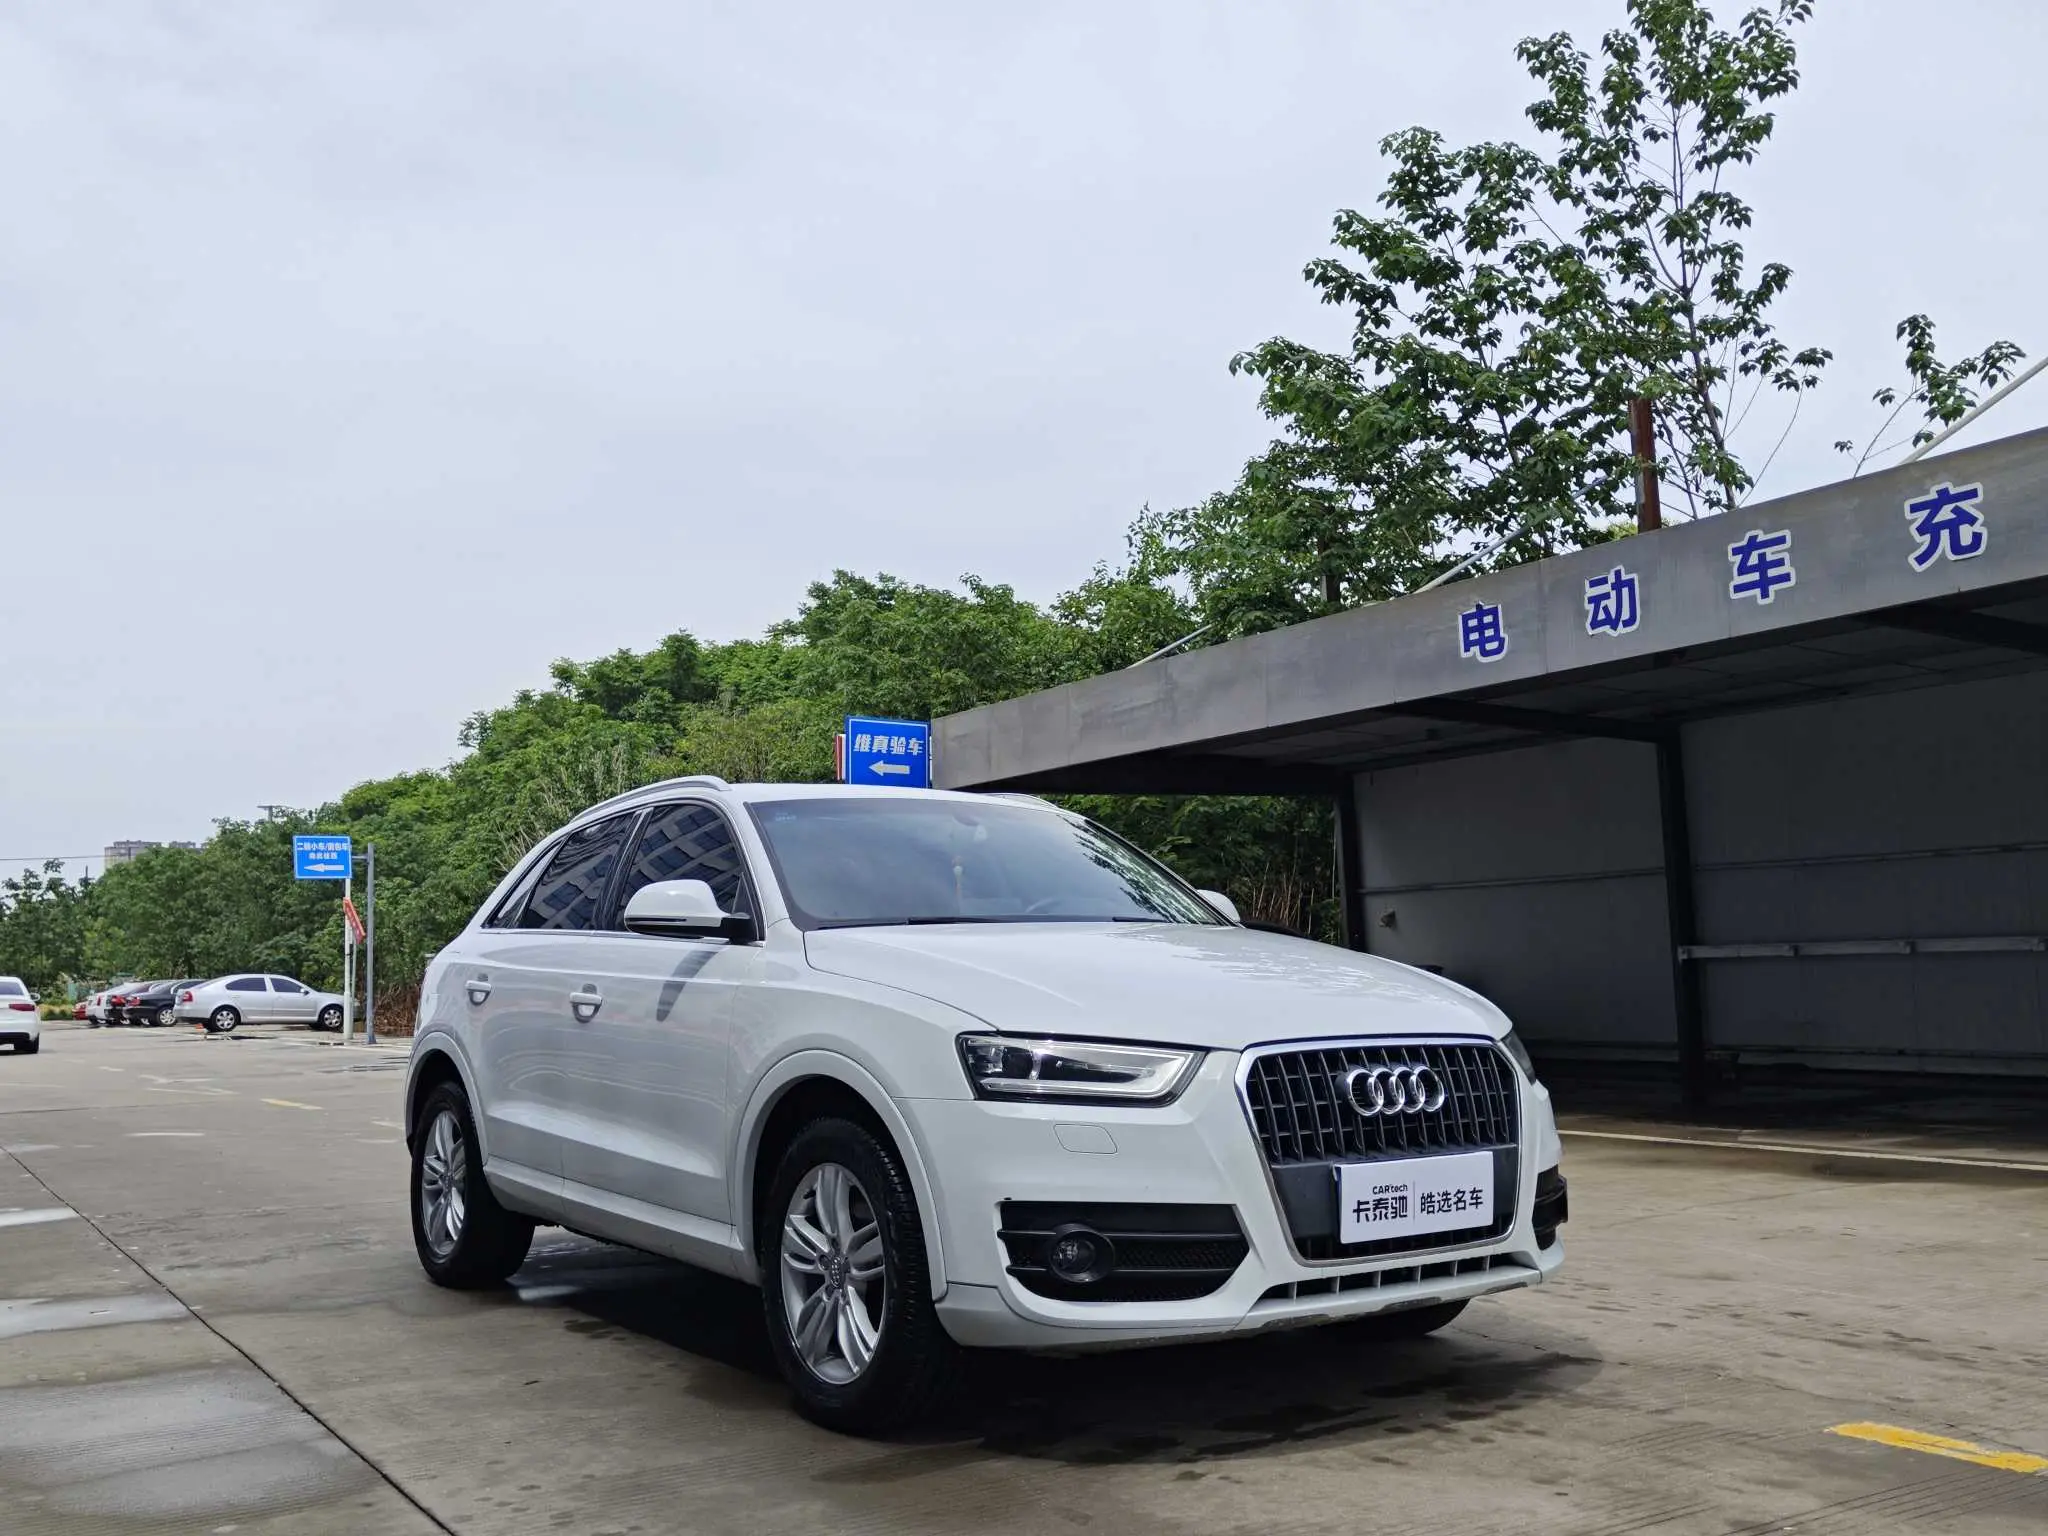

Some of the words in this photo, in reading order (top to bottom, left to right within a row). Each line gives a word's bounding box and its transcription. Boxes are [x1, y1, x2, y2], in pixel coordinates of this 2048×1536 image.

[1459, 483, 1986, 661] 电动车充
[1352, 1195, 1408, 1223] 卡泰驰
[1421, 1187, 1483, 1215] 皓选名车
